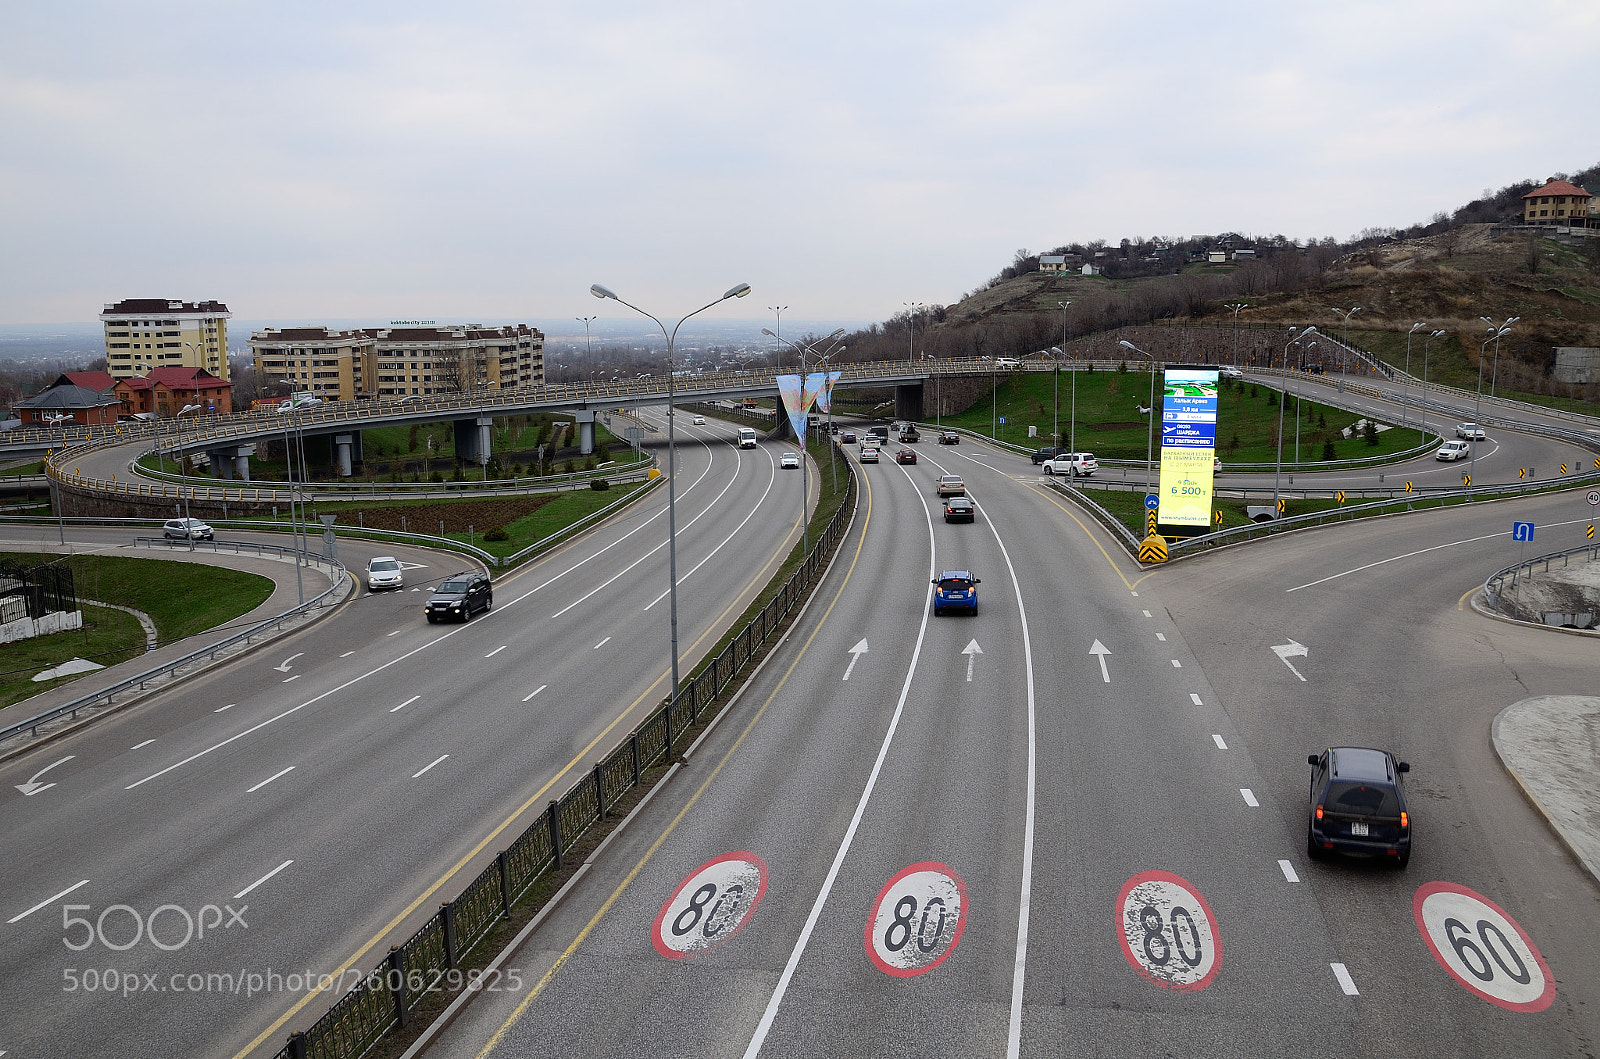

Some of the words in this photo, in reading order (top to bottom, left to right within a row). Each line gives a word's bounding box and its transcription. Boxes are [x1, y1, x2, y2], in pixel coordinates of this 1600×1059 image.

[1171, 486, 1178, 494] 6
[1181, 486, 1201, 495] 500
[671, 882, 744, 938] 80
[884, 894, 945, 952] 80
[1139, 905, 1203, 967] 80
[1443, 917, 1531, 985] 60
